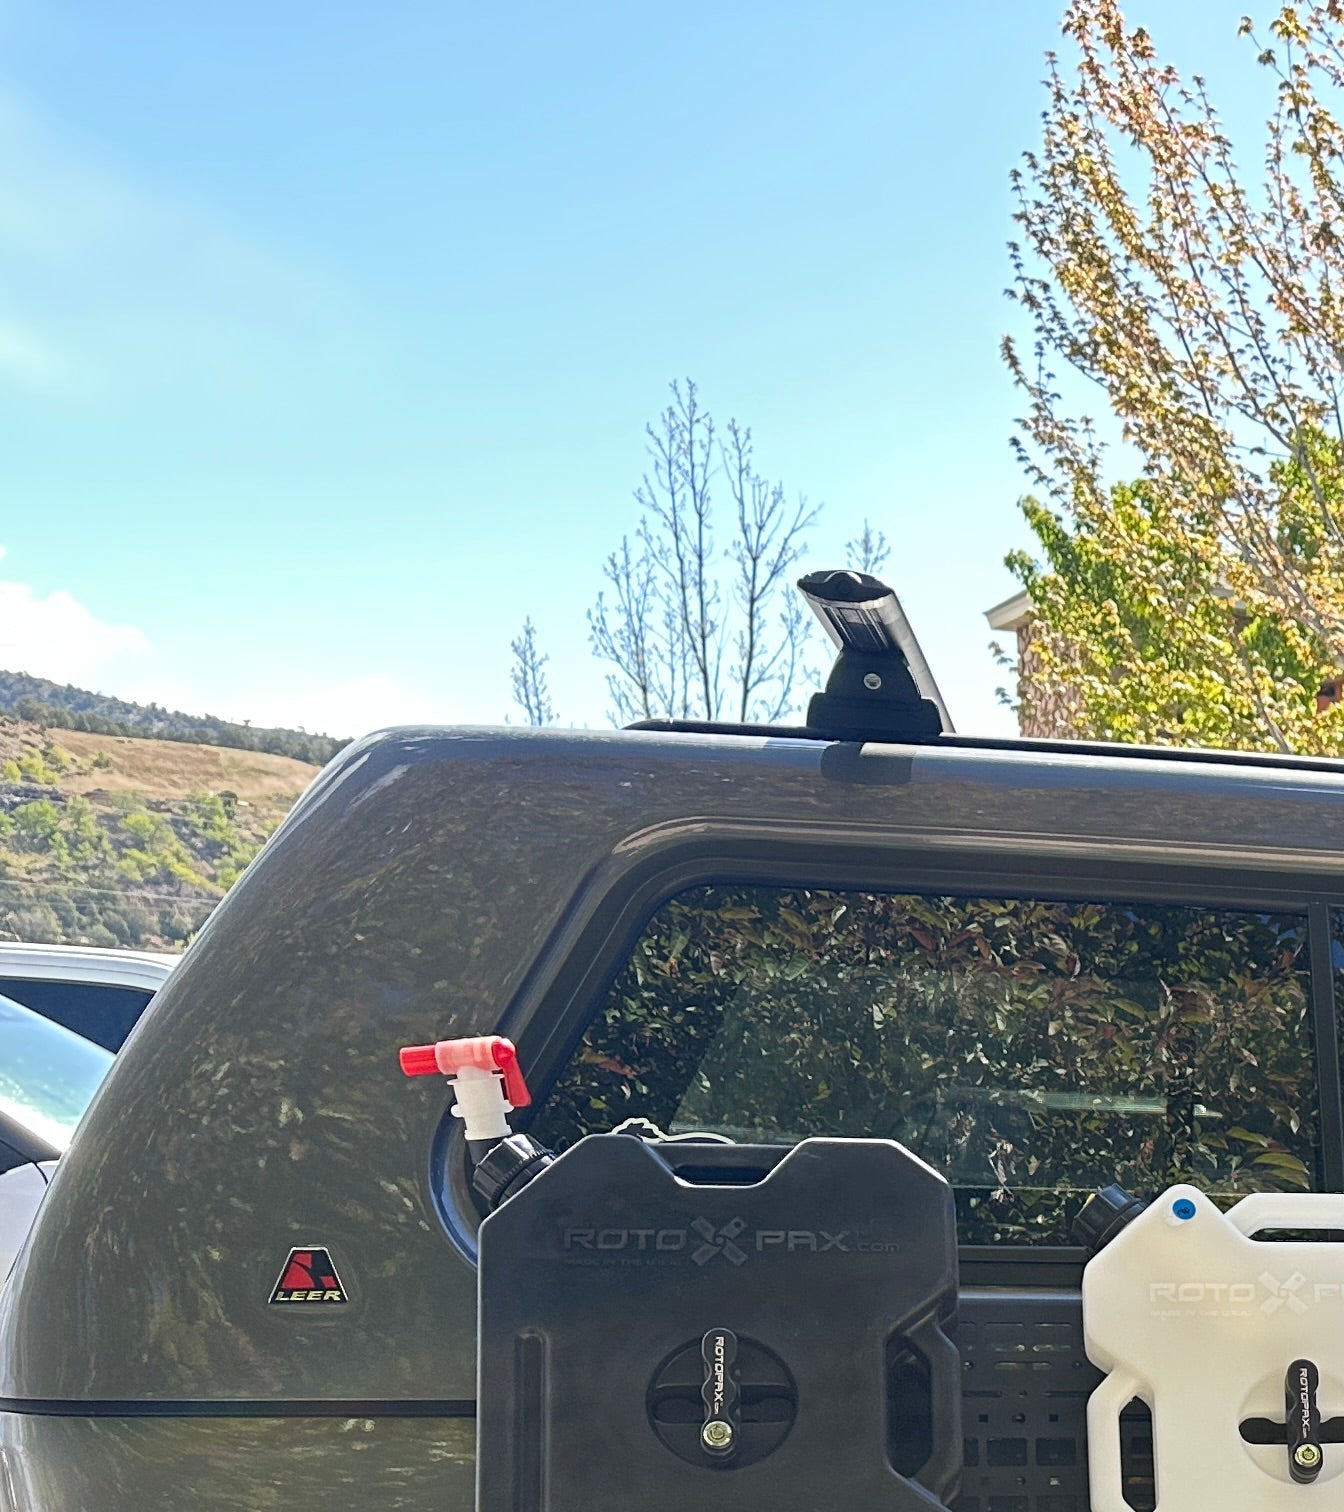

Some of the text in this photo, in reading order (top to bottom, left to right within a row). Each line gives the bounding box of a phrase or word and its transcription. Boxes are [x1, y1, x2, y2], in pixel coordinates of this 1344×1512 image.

[563, 1228, 687, 1250] ROTO
[275, 1290, 341, 1301] LEER
[1149, 1283, 1255, 1302] ROTO
